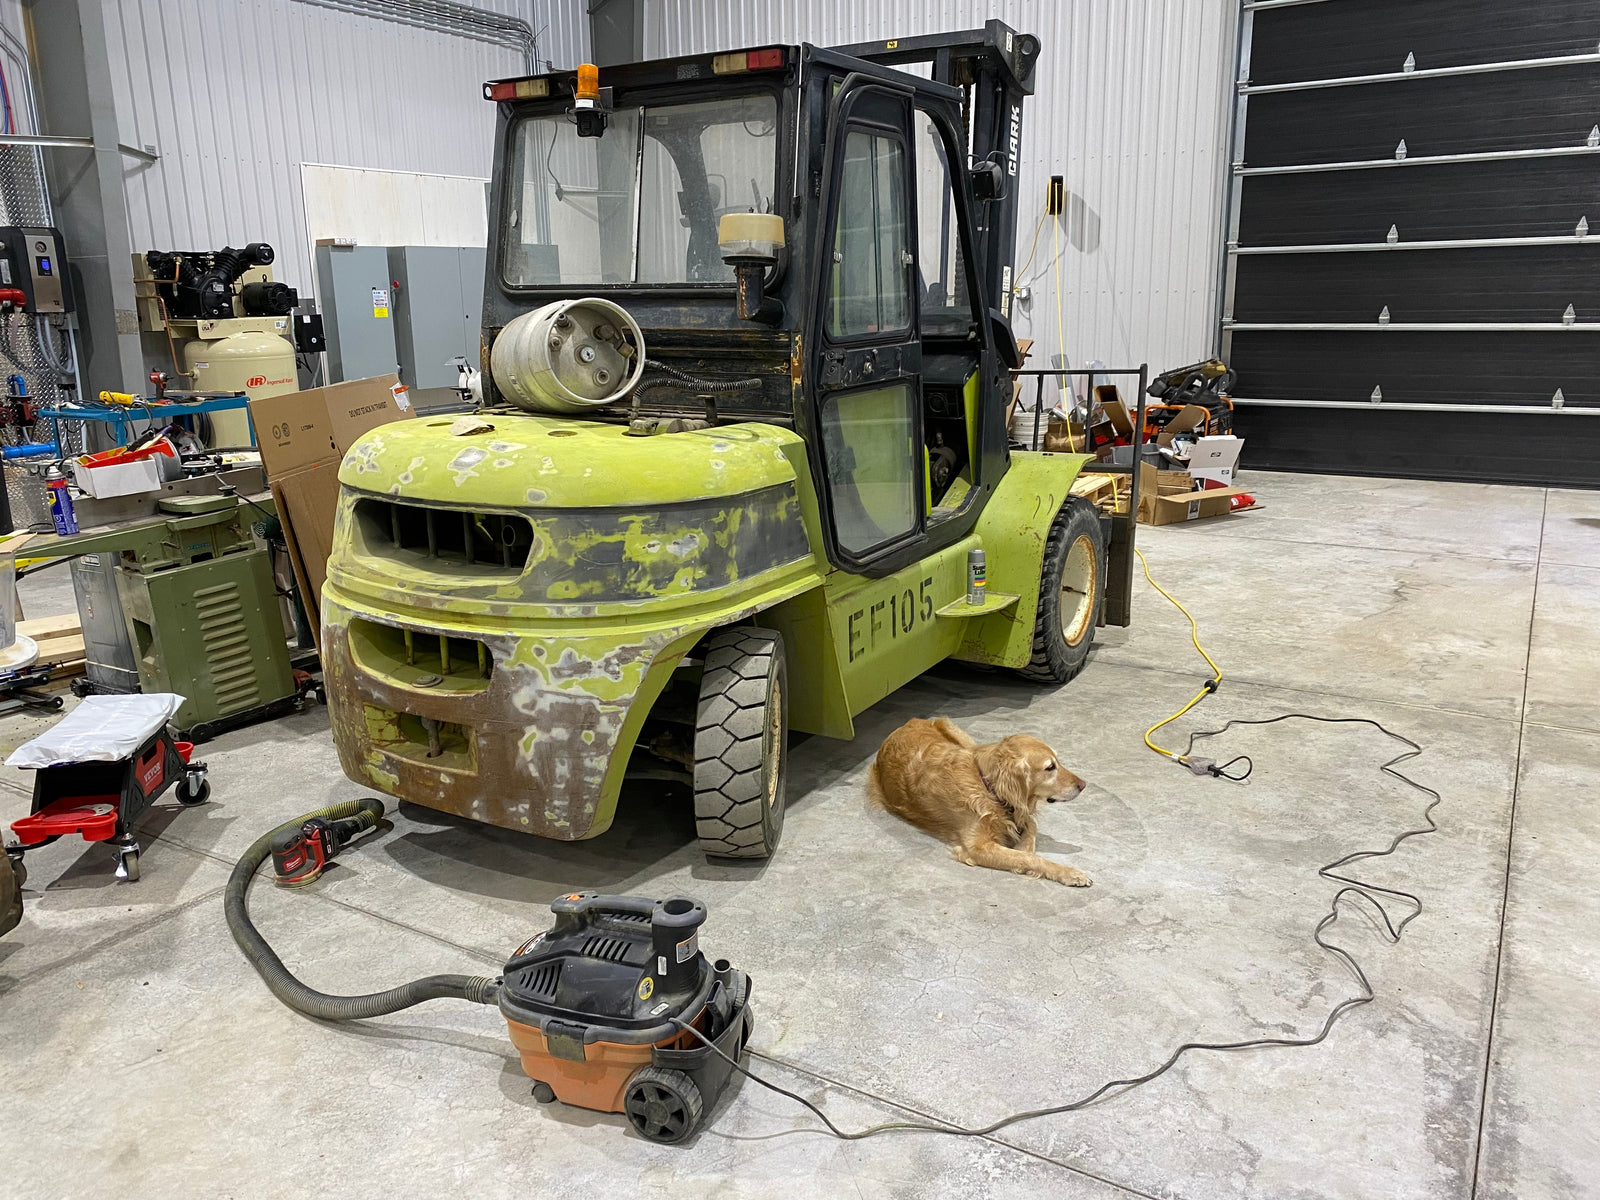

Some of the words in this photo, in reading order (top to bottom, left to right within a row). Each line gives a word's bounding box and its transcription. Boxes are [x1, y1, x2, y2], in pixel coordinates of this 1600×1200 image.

[1008, 104, 1020, 177] CLARK
[249, 377, 264, 387] IR
[848, 576, 933, 663] EF105
[143, 762, 161, 782] VEVOR
